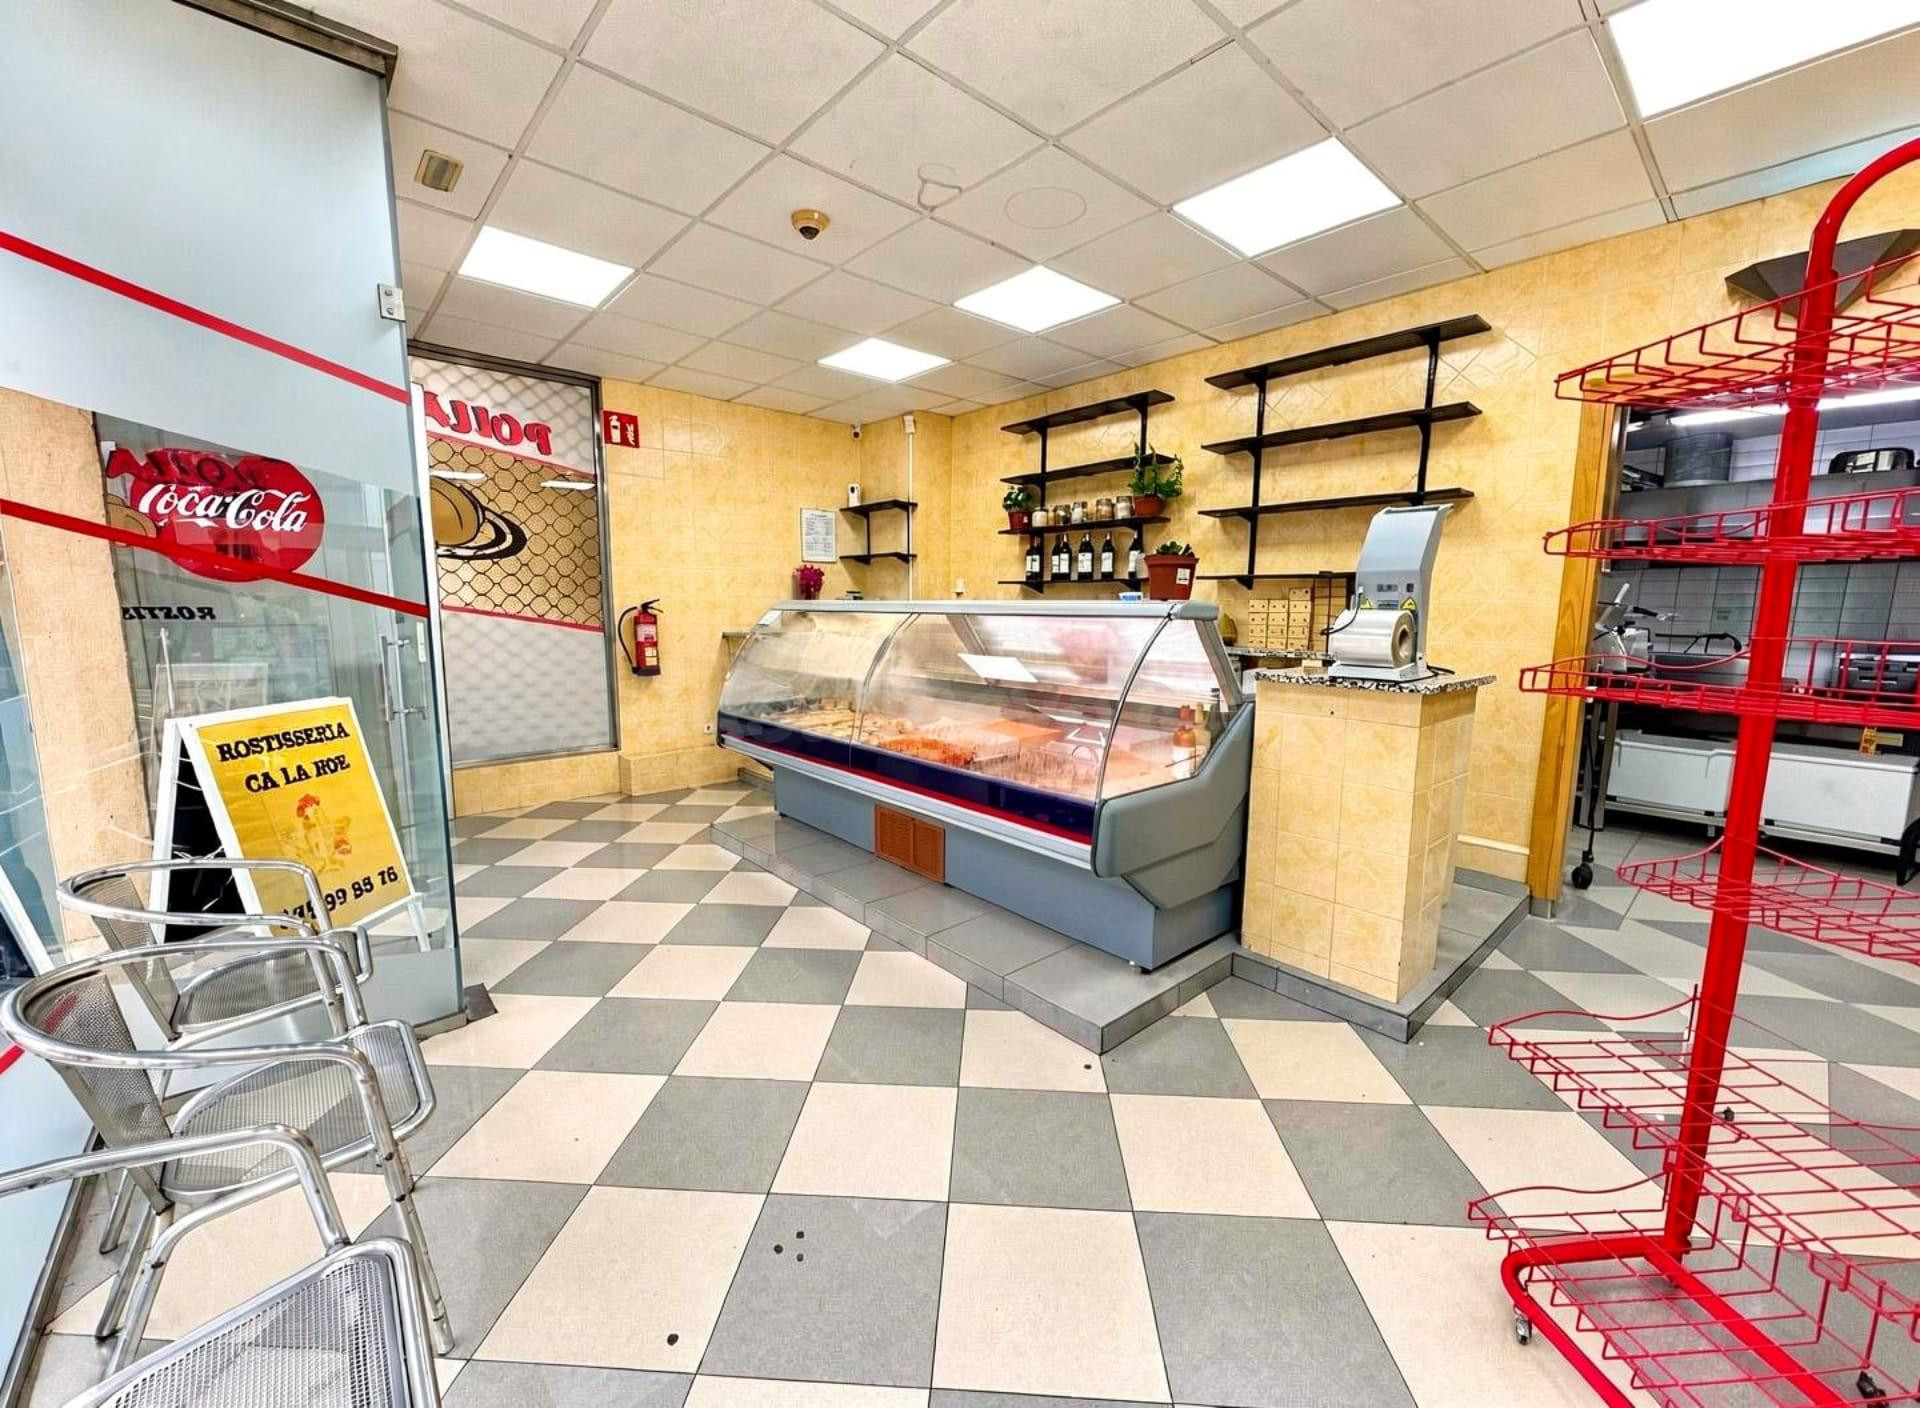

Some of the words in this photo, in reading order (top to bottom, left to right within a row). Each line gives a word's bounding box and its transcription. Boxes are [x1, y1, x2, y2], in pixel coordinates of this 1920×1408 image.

[138, 483, 311, 532] Coca-Cola
[216, 722, 350, 762] ROSTISSERIA
[245, 771, 280, 793] CA
[281, 764, 311, 785] LA
[324, 888, 347, 912] 99
[351, 876, 374, 899] 85
